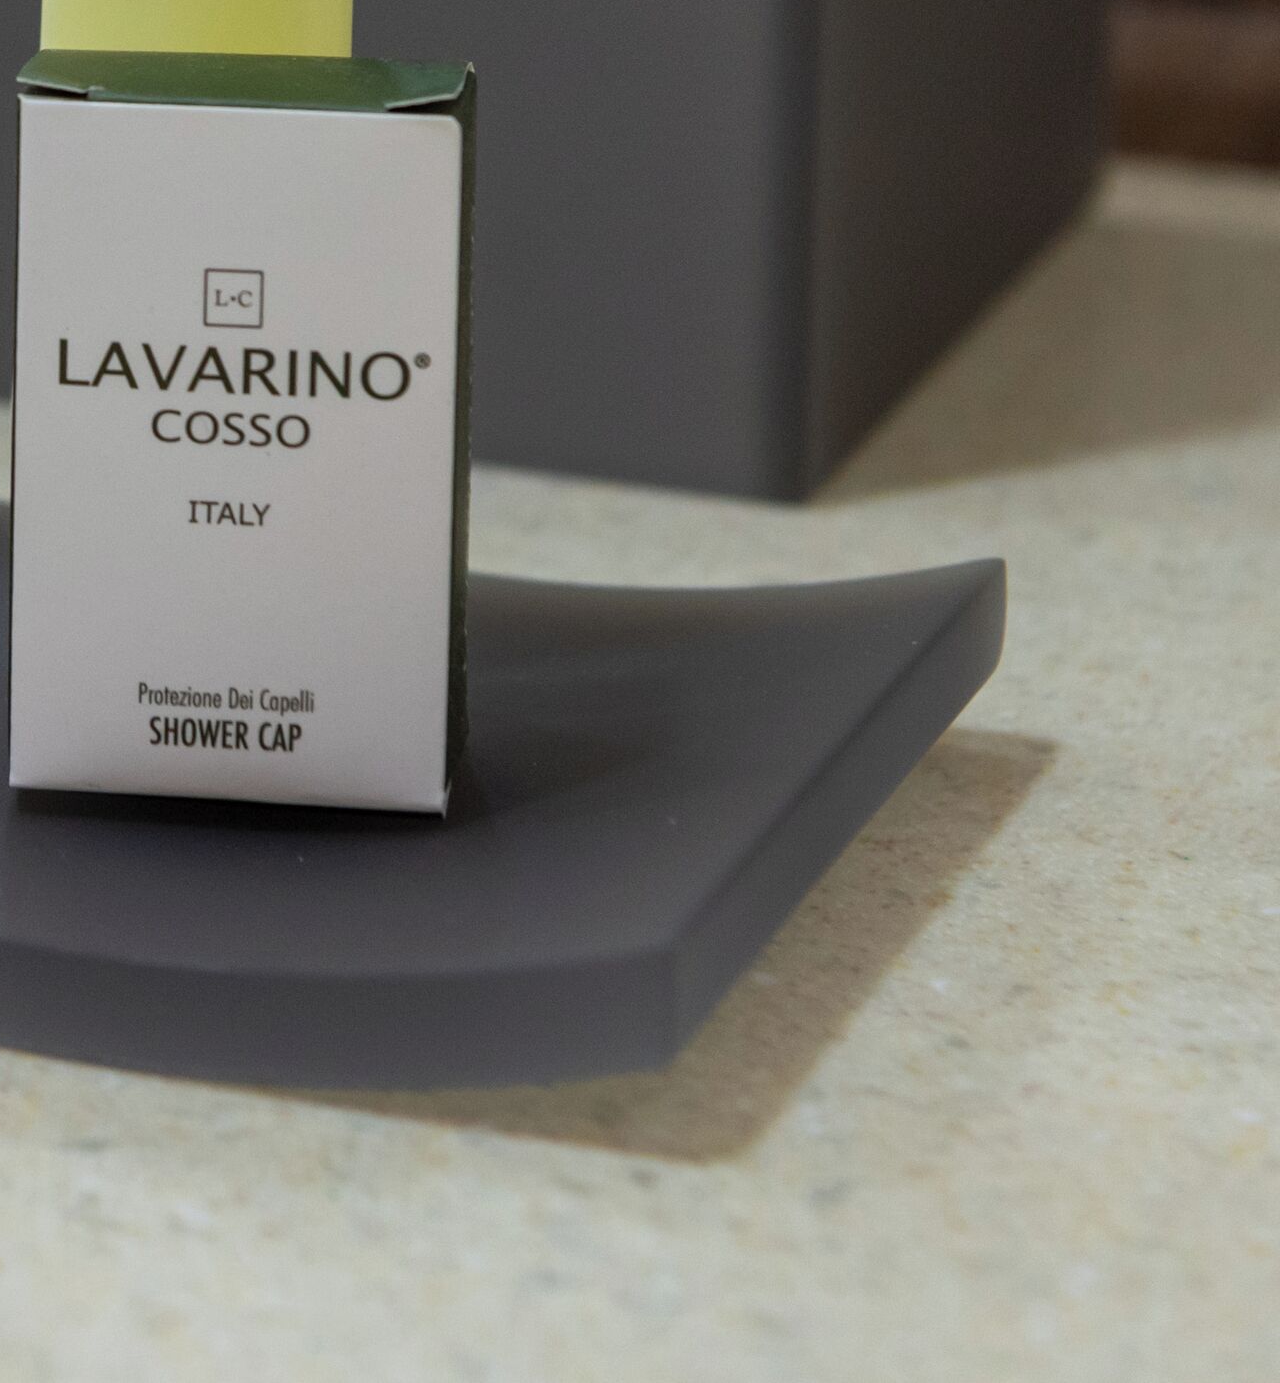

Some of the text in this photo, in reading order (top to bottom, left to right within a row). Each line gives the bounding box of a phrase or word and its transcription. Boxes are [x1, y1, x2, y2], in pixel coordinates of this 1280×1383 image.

[151, 408, 311, 449] COSSO
[188, 499, 271, 527] ITALY
[137, 681, 315, 717] Protezione Dei Capelli
[149, 716, 302, 753] SHOWER CAP
